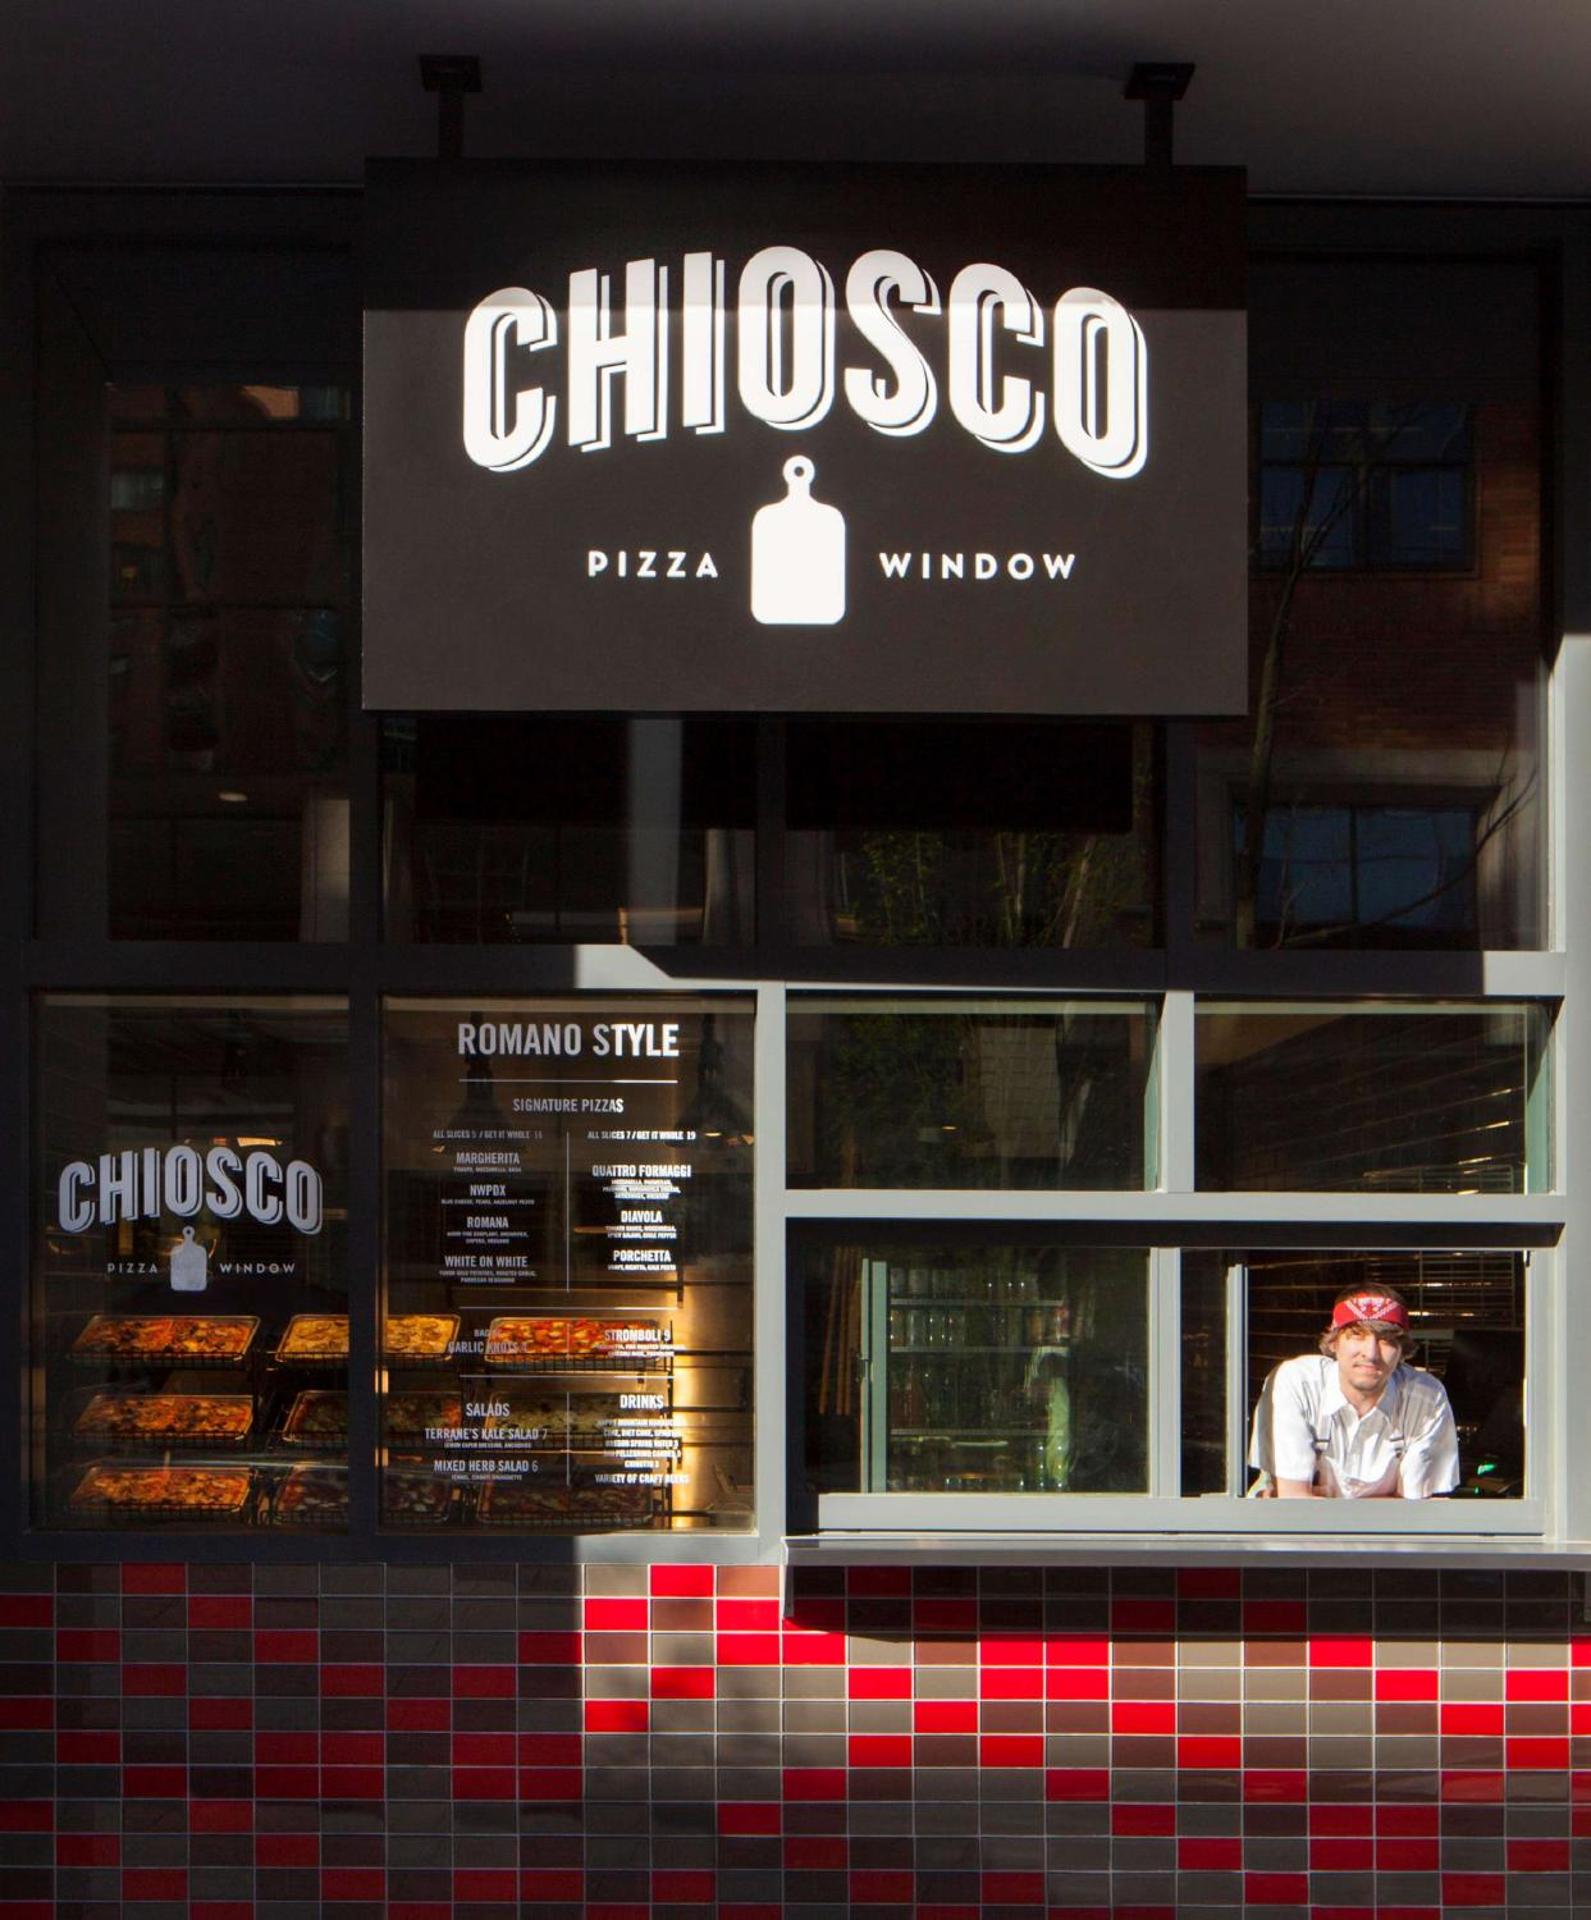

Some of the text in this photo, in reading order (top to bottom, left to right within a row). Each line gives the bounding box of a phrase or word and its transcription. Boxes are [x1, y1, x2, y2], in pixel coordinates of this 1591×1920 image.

[463, 246, 1147, 479] CHIOSCO
[588, 550, 1076, 580] PIZZA WINDOW
[458, 1023, 679, 1057] ROMANO STYLE
[513, 1098, 624, 1113] SIGNATURE PIZZAS
[456, 1152, 520, 1165] MARGHERITA
[592, 1164, 691, 1178] QUATTRO FORMAGGI
[58, 1145, 323, 1235] CHIOSCO
[469, 1184, 506, 1196] NWPDX
[466, 1216, 509, 1228] ROMANA
[620, 1210, 663, 1223] DIAVOLA
[444, 1255, 529, 1267] WHITE ON WHITE
[613, 1250, 672, 1262] PORCHETTA
[107, 1262, 296, 1274] PIZZA WINDOW
[620, 1394, 664, 1409] DRINKS
[466, 1402, 510, 1417] SALADS
[481, 1427, 507, 1440] KALE
[509, 1428, 539, 1440] SALAD
[434, 1459, 466, 1472] MIXED
[468, 1459, 496, 1472] HERB
[498, 1460, 529, 1472] SALAD
